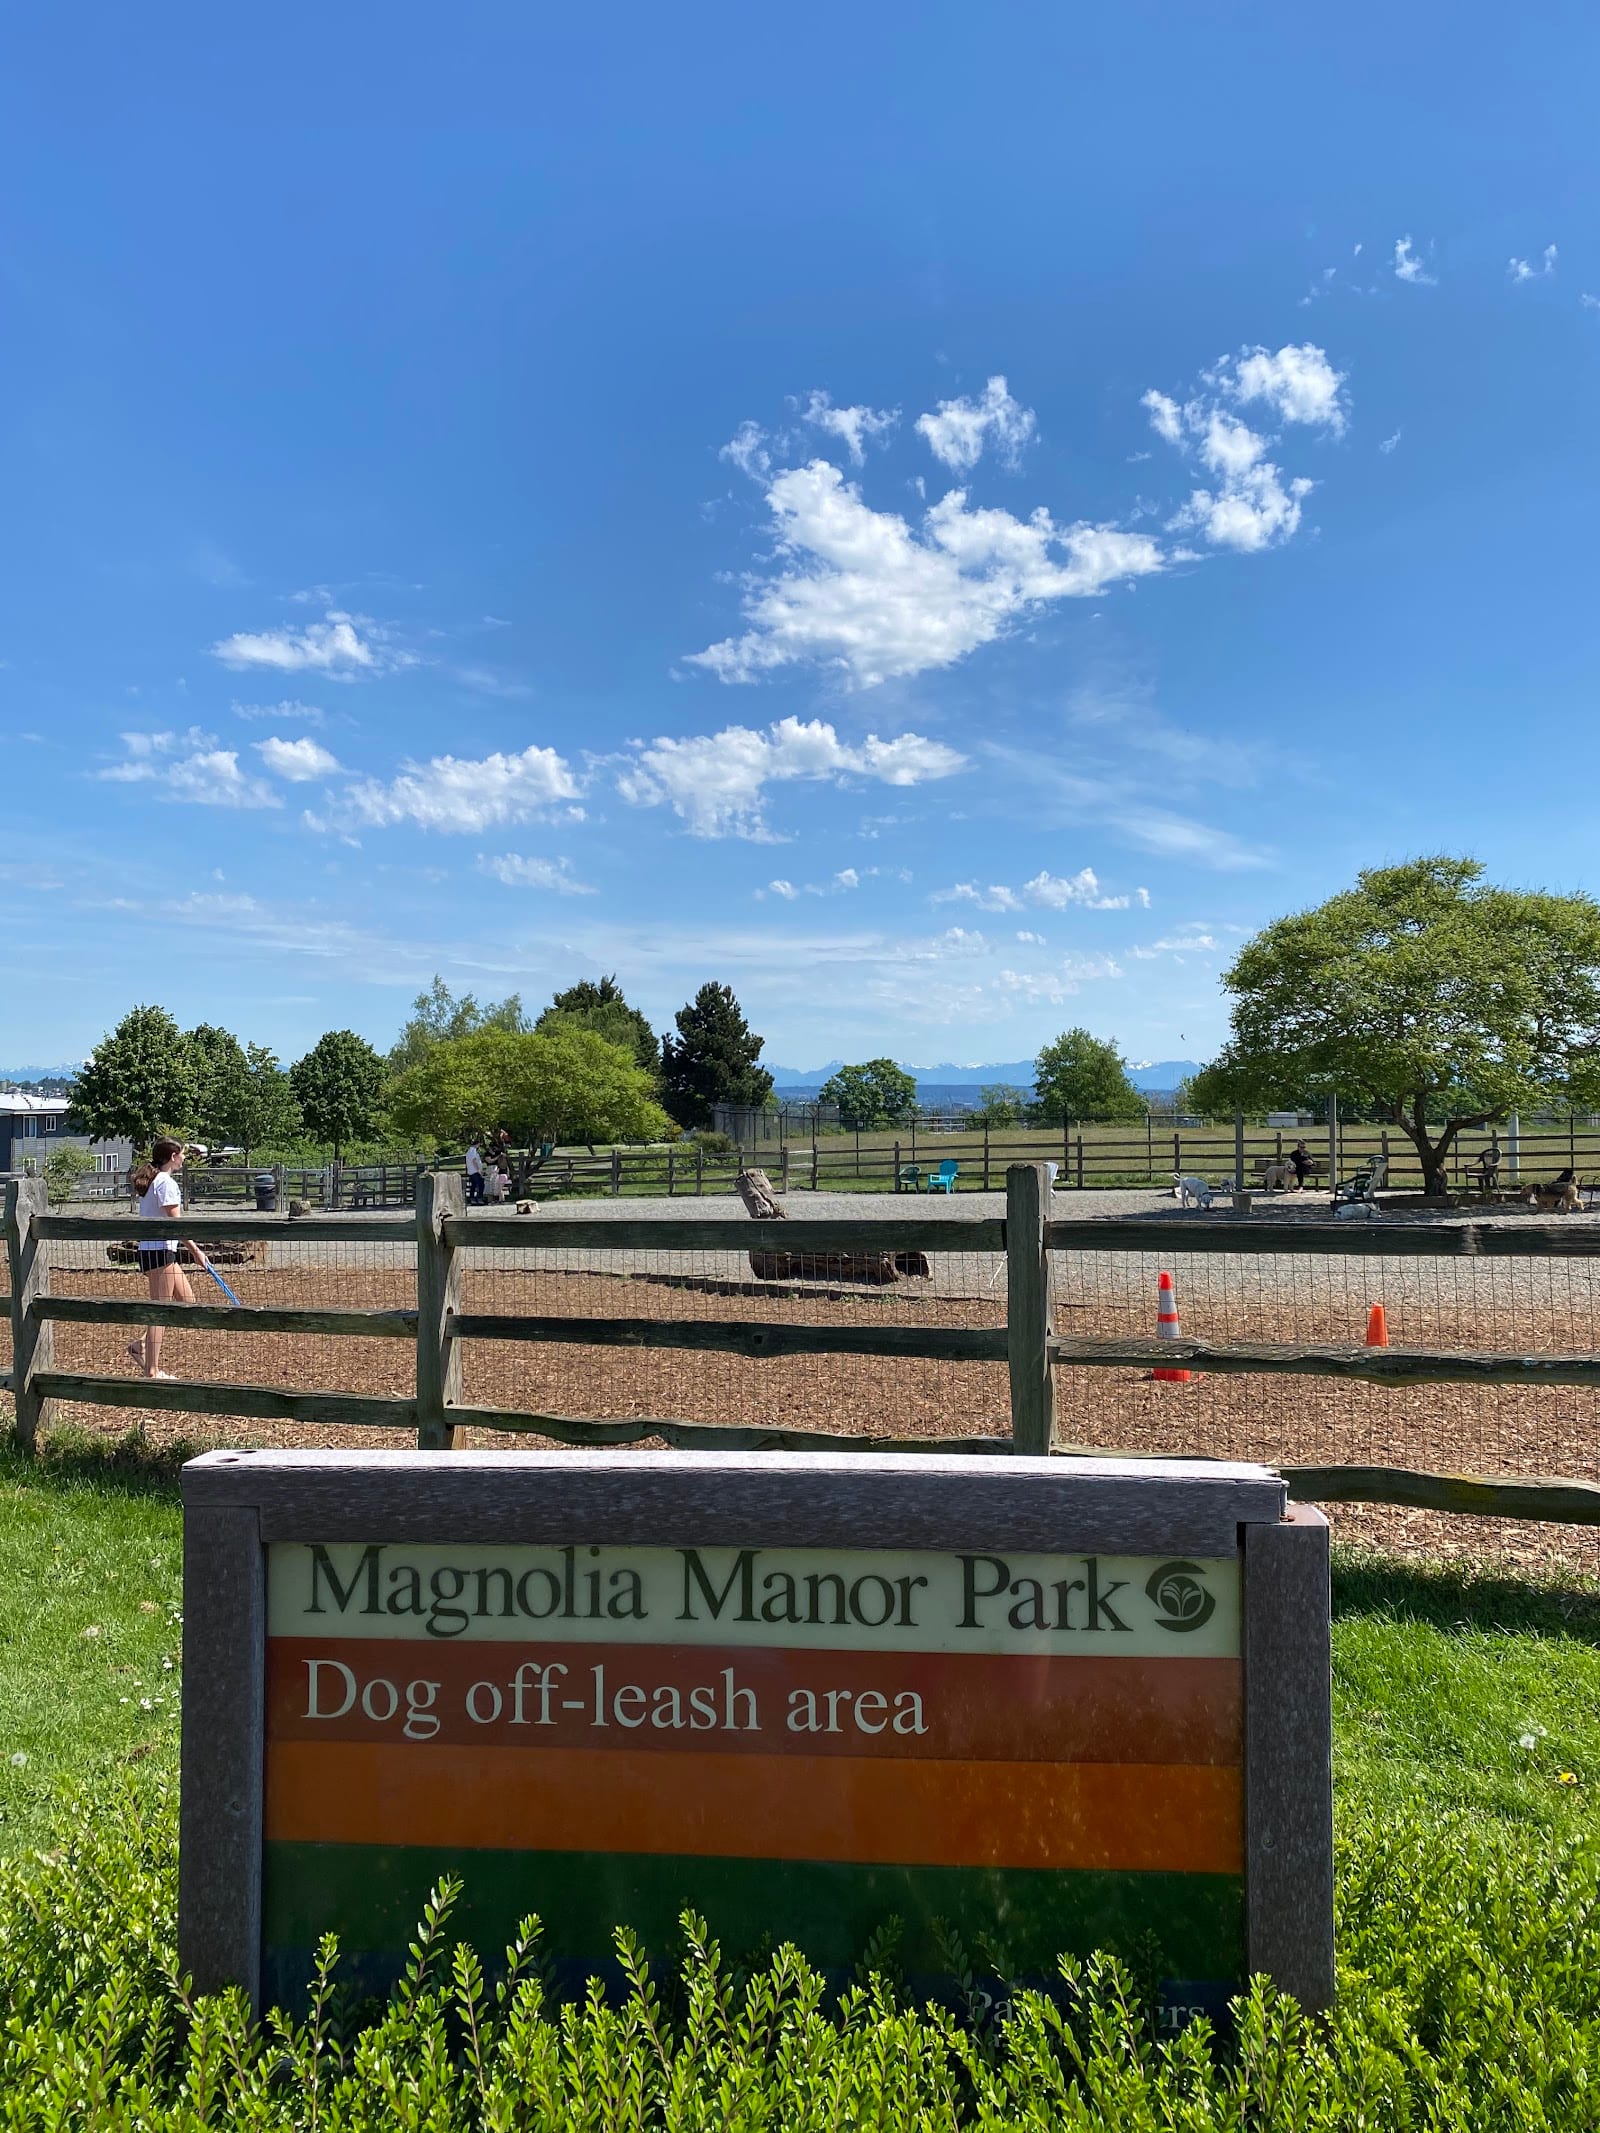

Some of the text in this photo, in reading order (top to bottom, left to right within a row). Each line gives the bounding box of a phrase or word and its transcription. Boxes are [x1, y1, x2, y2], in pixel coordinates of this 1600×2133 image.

[303, 1543, 1133, 1637] Magnolia Manor Park
[302, 1659, 929, 1740] Dog off-leash area
